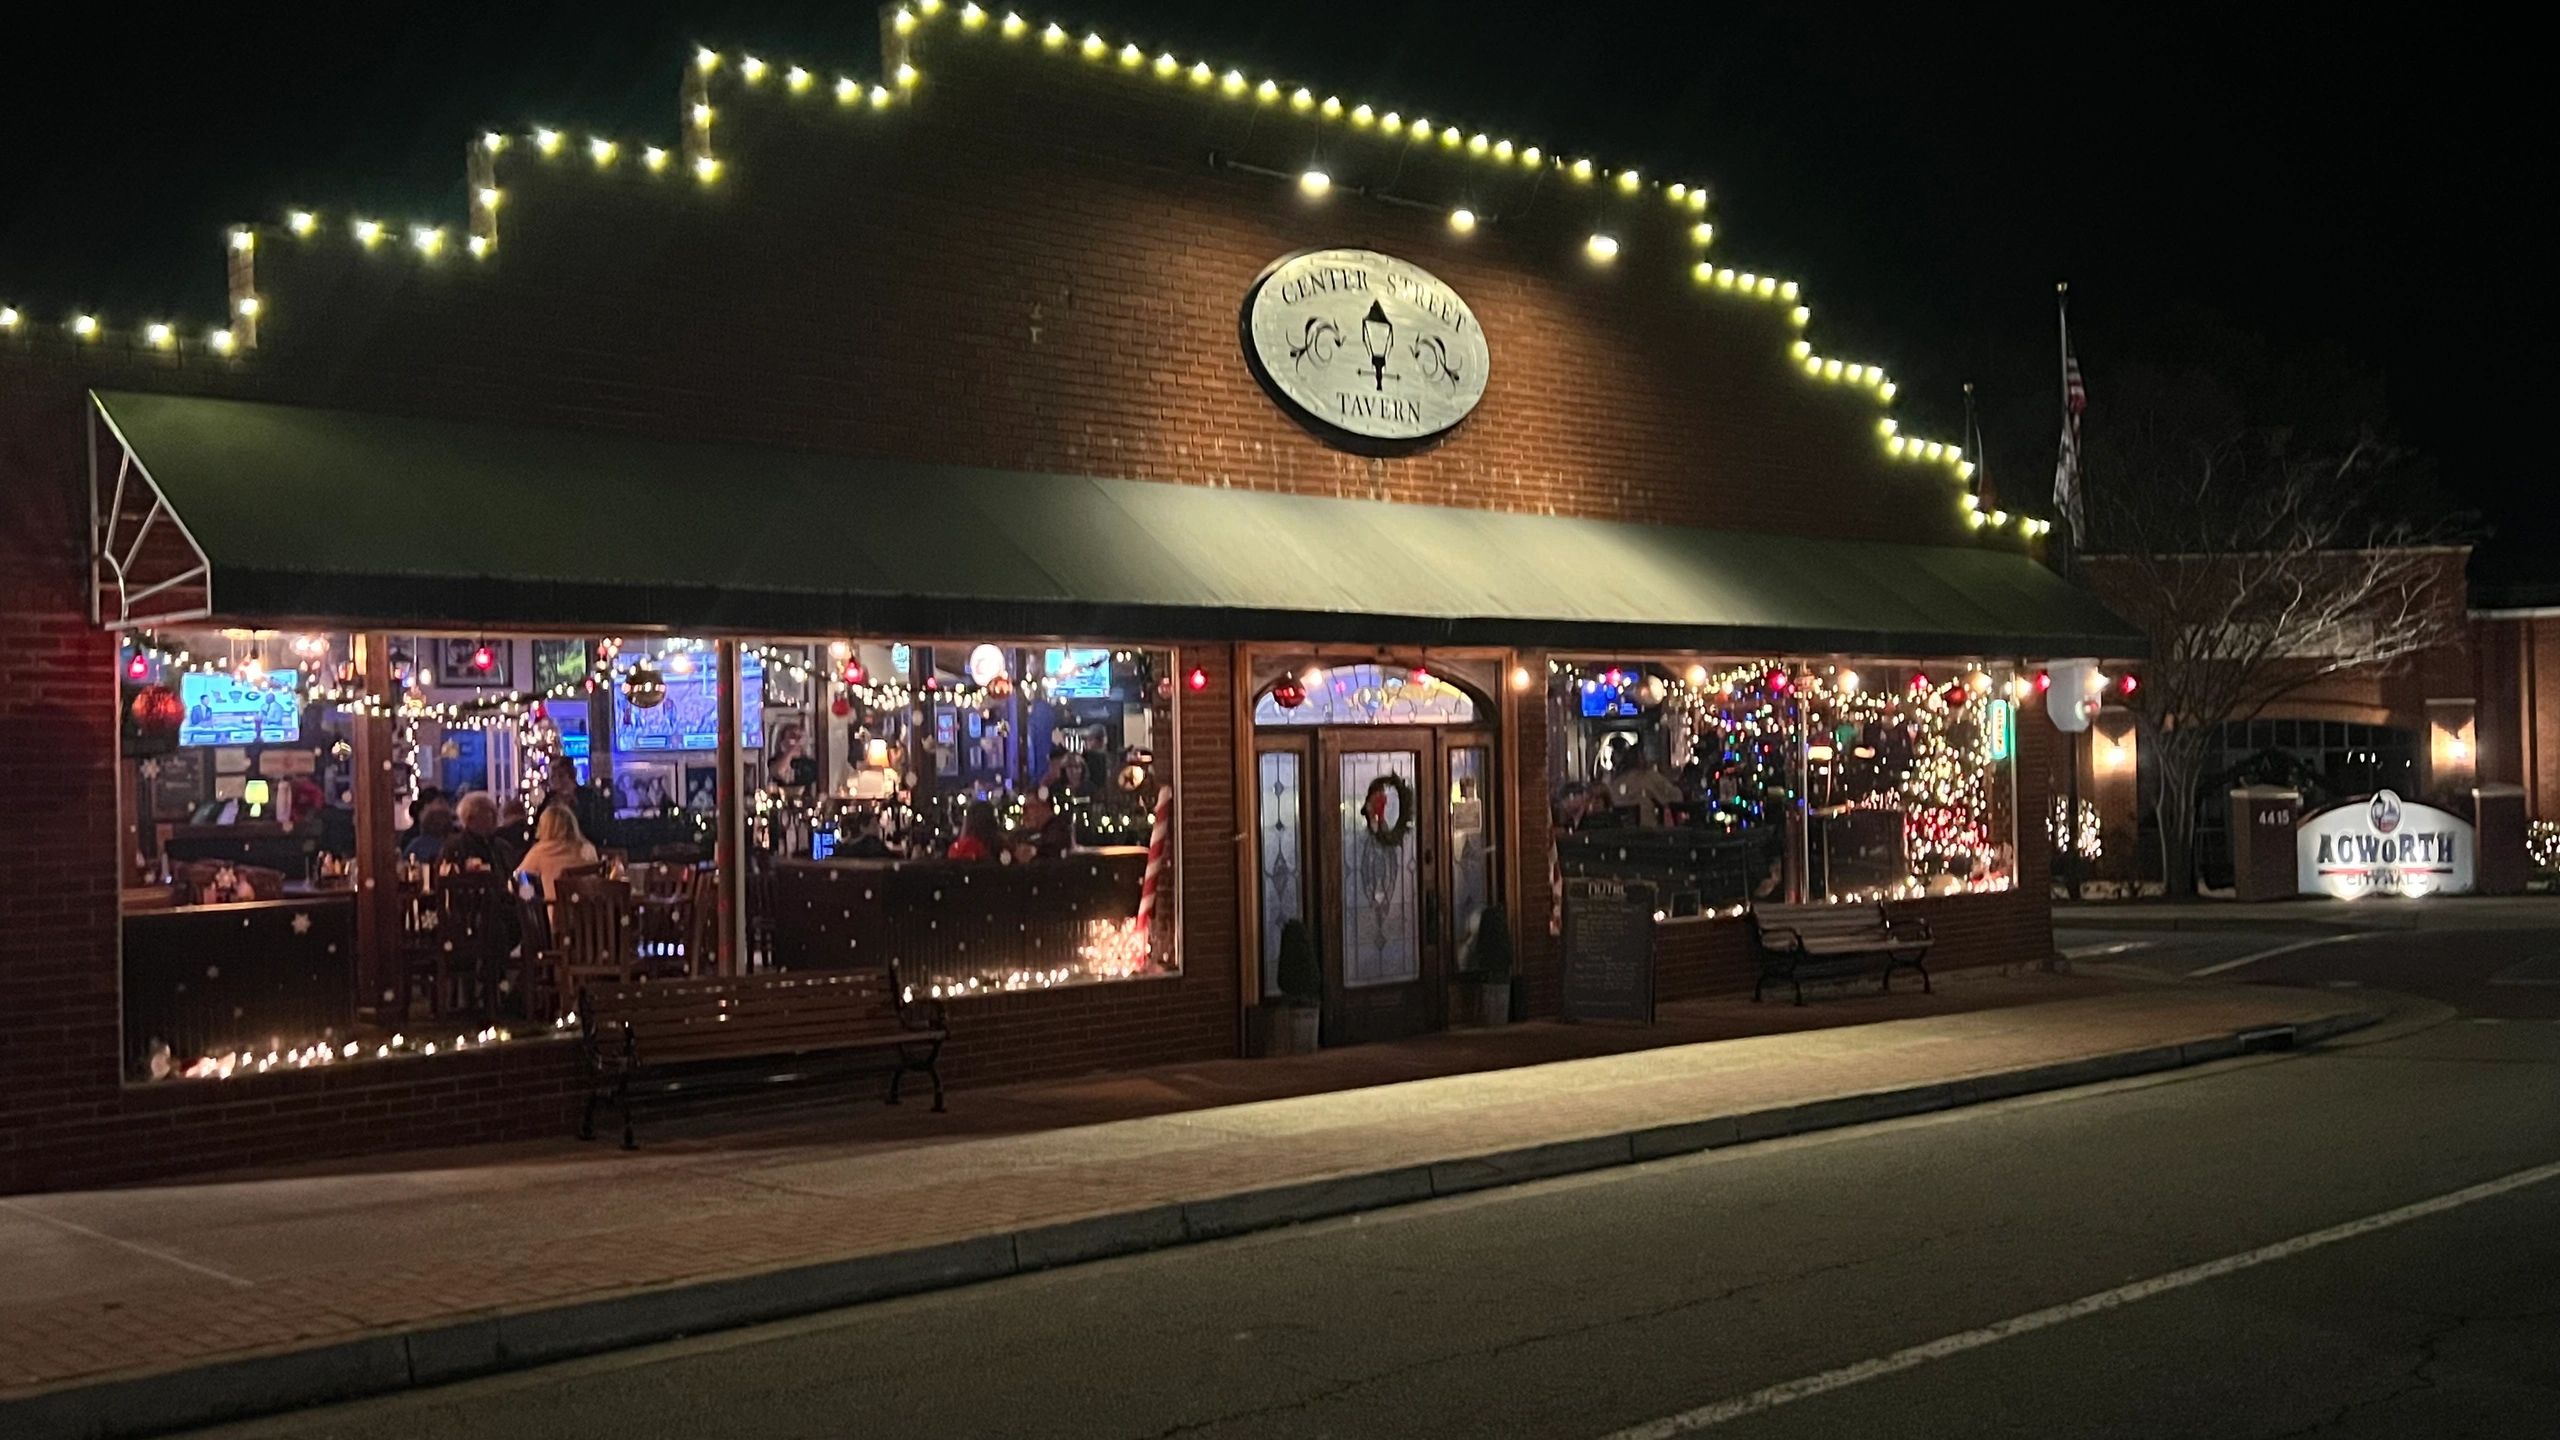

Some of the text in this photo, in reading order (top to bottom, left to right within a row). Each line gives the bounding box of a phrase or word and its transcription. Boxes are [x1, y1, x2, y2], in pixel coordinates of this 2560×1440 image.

[1282, 269, 1467, 333] CENTER STREET
[1337, 392, 1420, 423] TAVERN
[2259, 810, 2289, 825] 4415
[2318, 834, 2454, 863] ACWORTH
